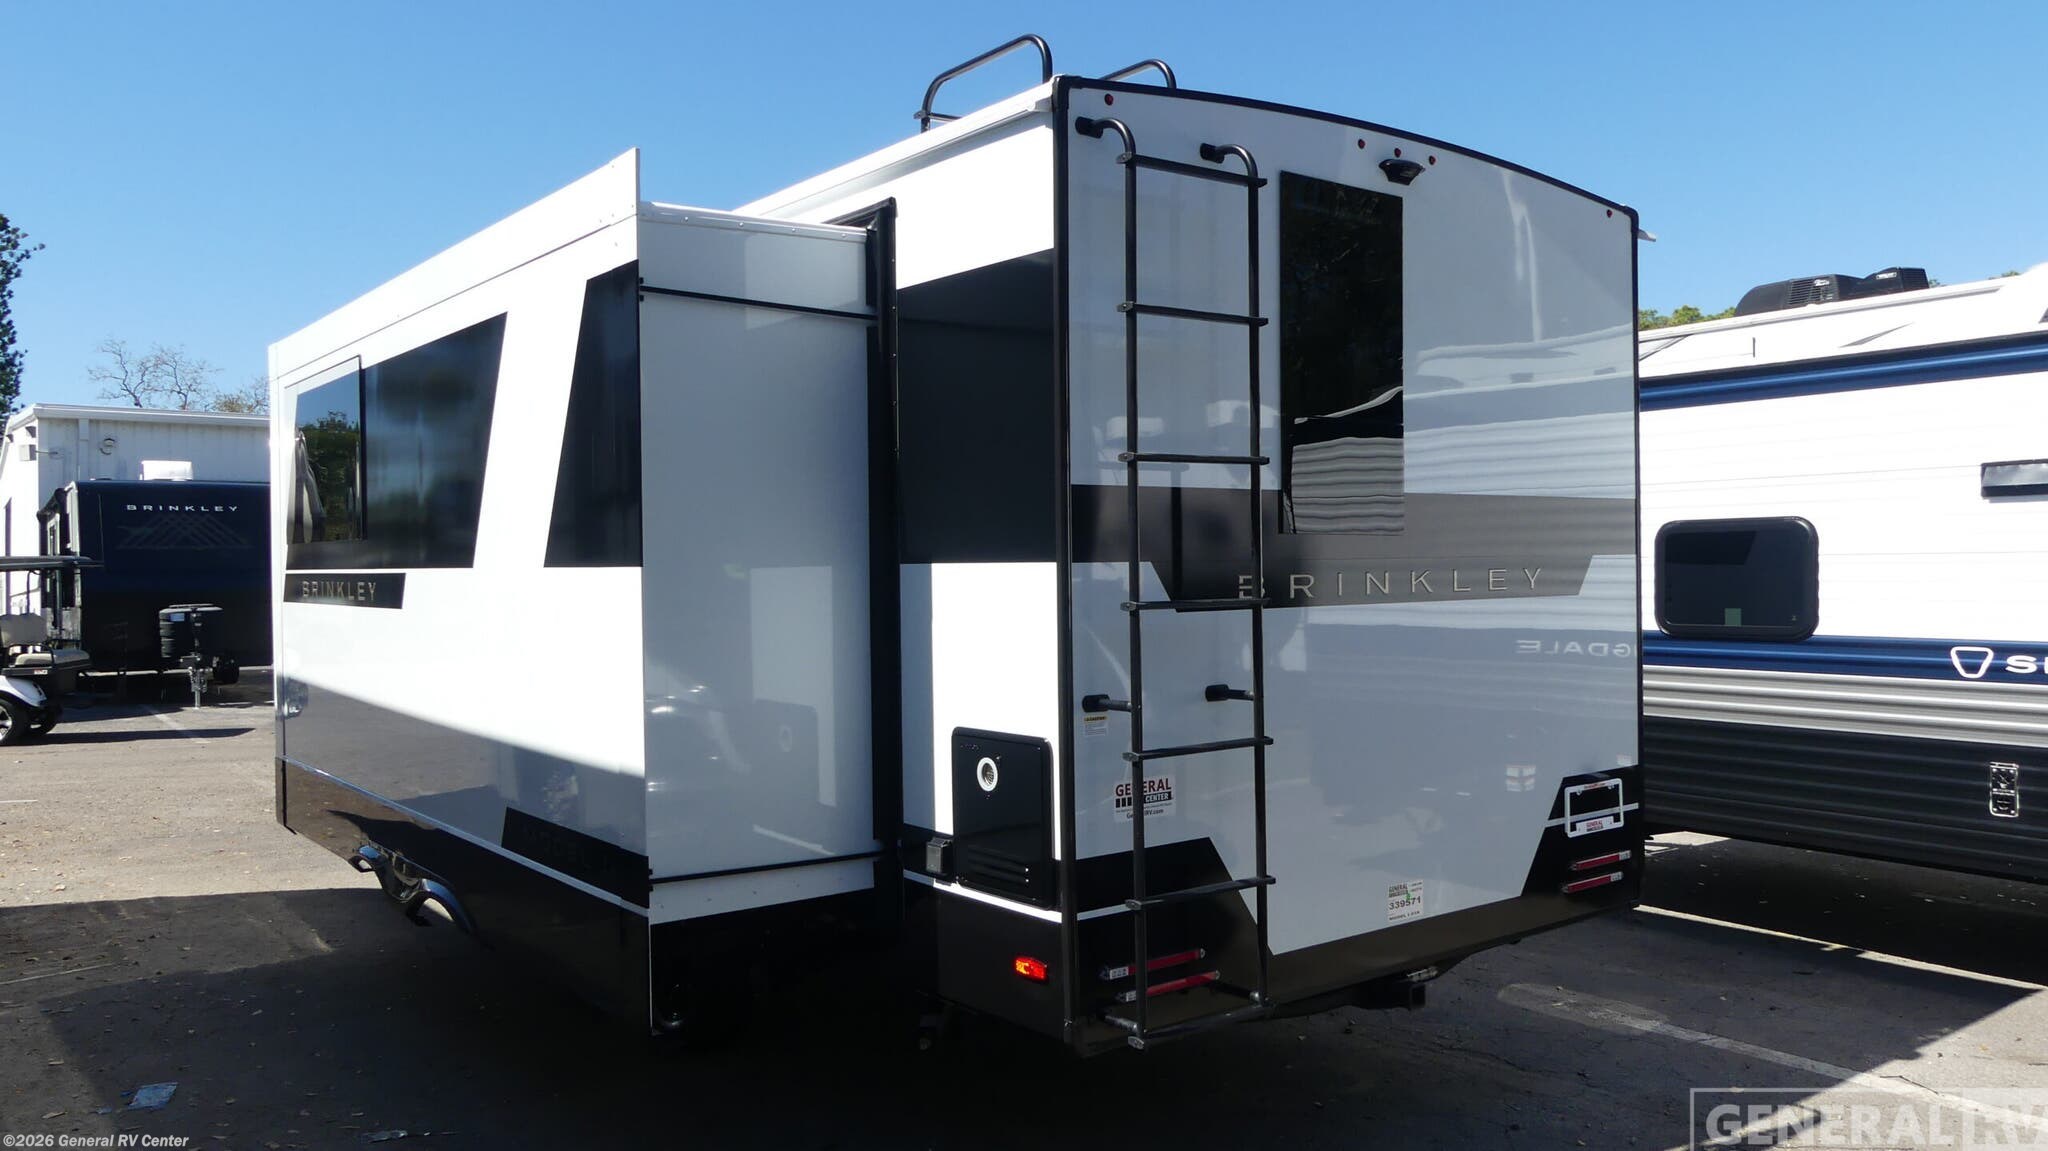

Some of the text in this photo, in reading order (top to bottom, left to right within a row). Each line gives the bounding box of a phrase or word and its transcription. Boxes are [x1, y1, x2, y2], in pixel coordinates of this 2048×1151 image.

[126, 504, 238, 513] BRINKLEY
[301, 579, 376, 602] BRINKLEY
[1238, 567, 1542, 600] BRINKLEY
[1115, 778, 1172, 797] GEERAL
[1145, 793, 1169, 802] CENTER
[1389, 895, 1421, 910] 339571
